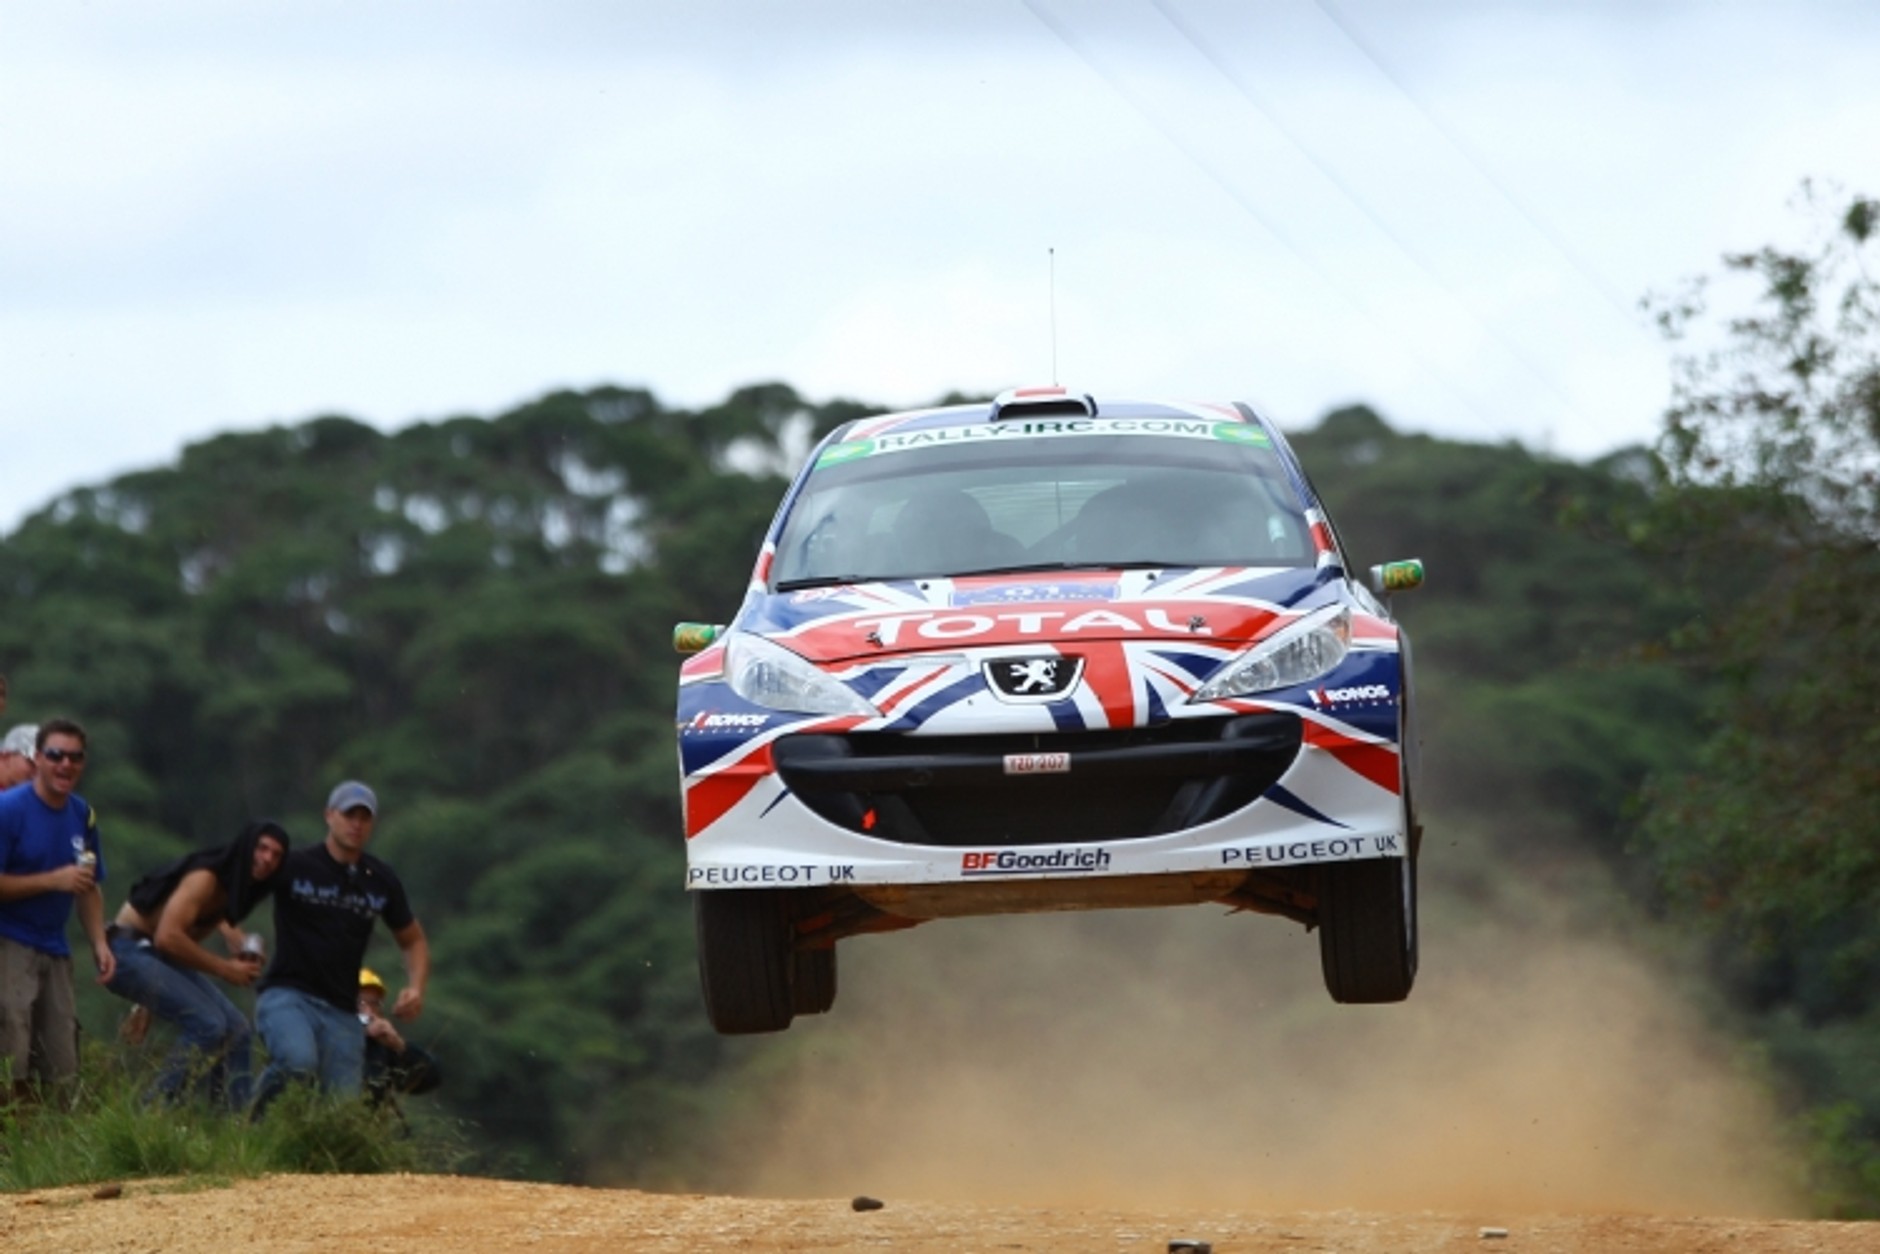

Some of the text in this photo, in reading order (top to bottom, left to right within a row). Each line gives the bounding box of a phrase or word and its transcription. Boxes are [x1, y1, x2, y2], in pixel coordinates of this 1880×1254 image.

[878, 418, 1209, 450] RALLY-IRC.COM
[854, 609, 1212, 646] TOTAL
[961, 848, 1111, 870] BFGoodrich
[1222, 834, 1397, 864] PEUGEOT UK
[689, 864, 855, 884] PEUGEOT UK
